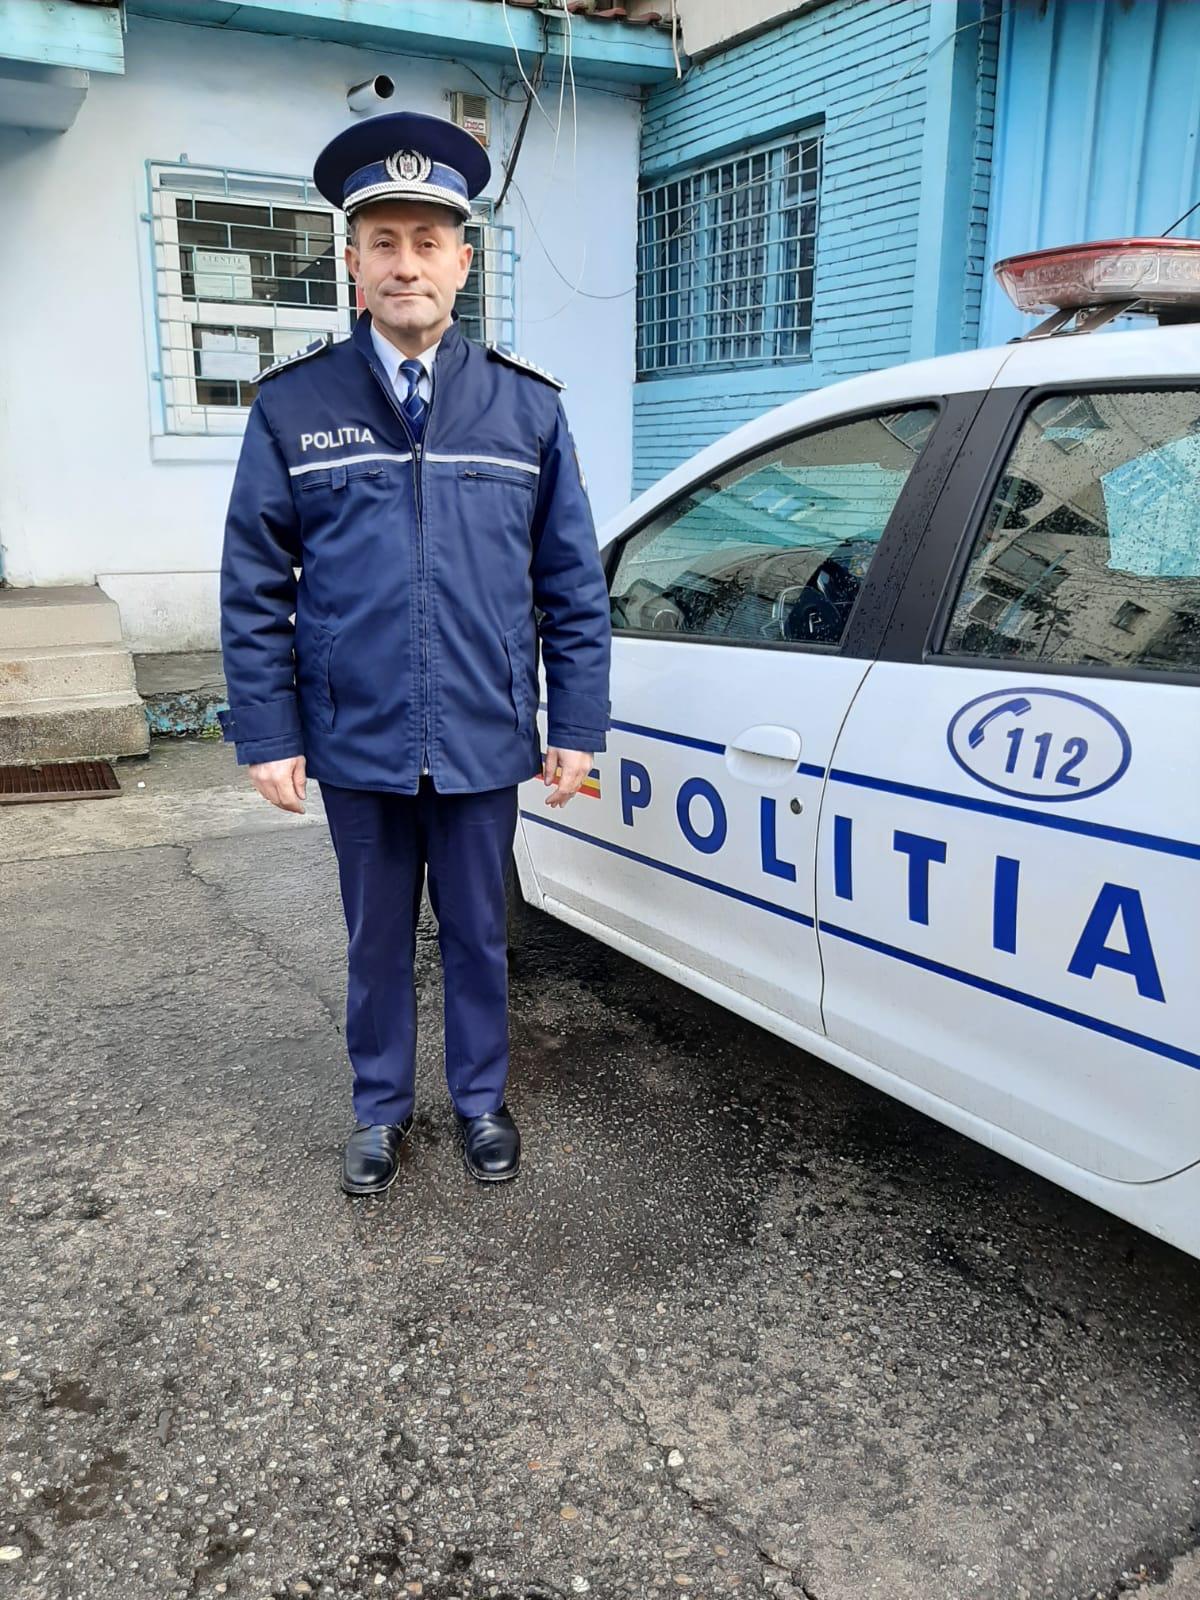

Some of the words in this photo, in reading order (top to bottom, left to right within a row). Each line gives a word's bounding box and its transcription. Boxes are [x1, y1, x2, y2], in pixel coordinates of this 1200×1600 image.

[300, 427, 376, 452] POLITIA
[1005, 727, 1089, 787] 112
[620, 757, 1167, 1004] POLITIA
